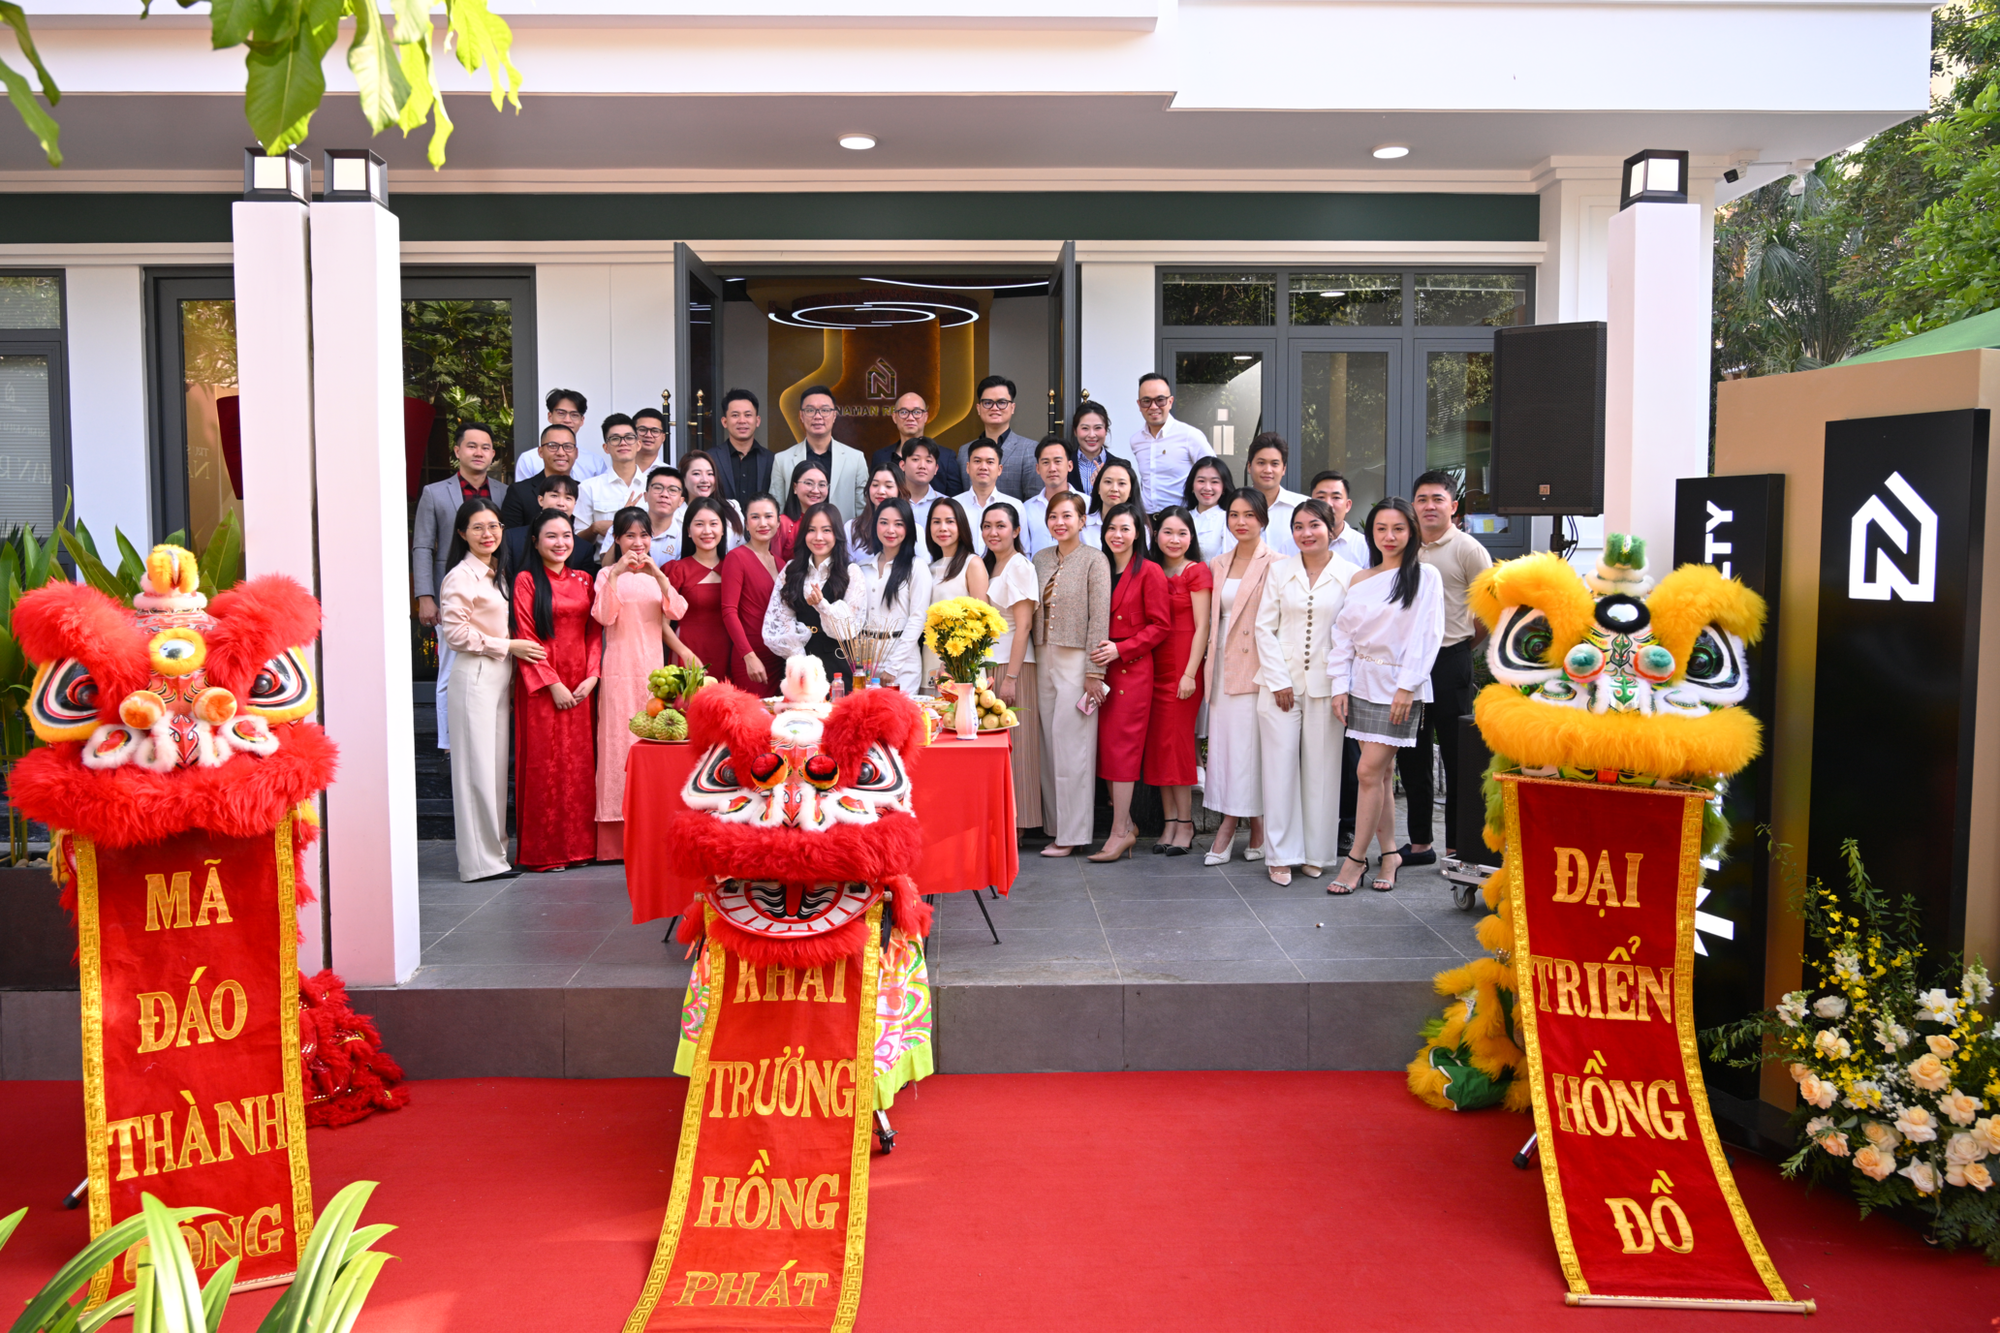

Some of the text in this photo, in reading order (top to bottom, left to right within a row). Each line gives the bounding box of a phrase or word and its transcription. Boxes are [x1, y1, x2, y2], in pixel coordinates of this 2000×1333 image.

[144, 858, 233, 931] MÃ
[1552, 846, 1644, 918] ĐẠI
[136, 966, 249, 1054] ĐÁO
[733, 953, 847, 1003] KHAI
[1530, 935, 1676, 1024] TRIỂN
[706, 1045, 857, 1119] TRƯỞNG
[1552, 1049, 1688, 1141] HỒNG
[107, 1090, 288, 1182] THÀNH
[694, 1149, 841, 1230] HỒNG
[1604, 1169, 1695, 1255] ĐỒ
[673, 1259, 829, 1308] PHÁT
